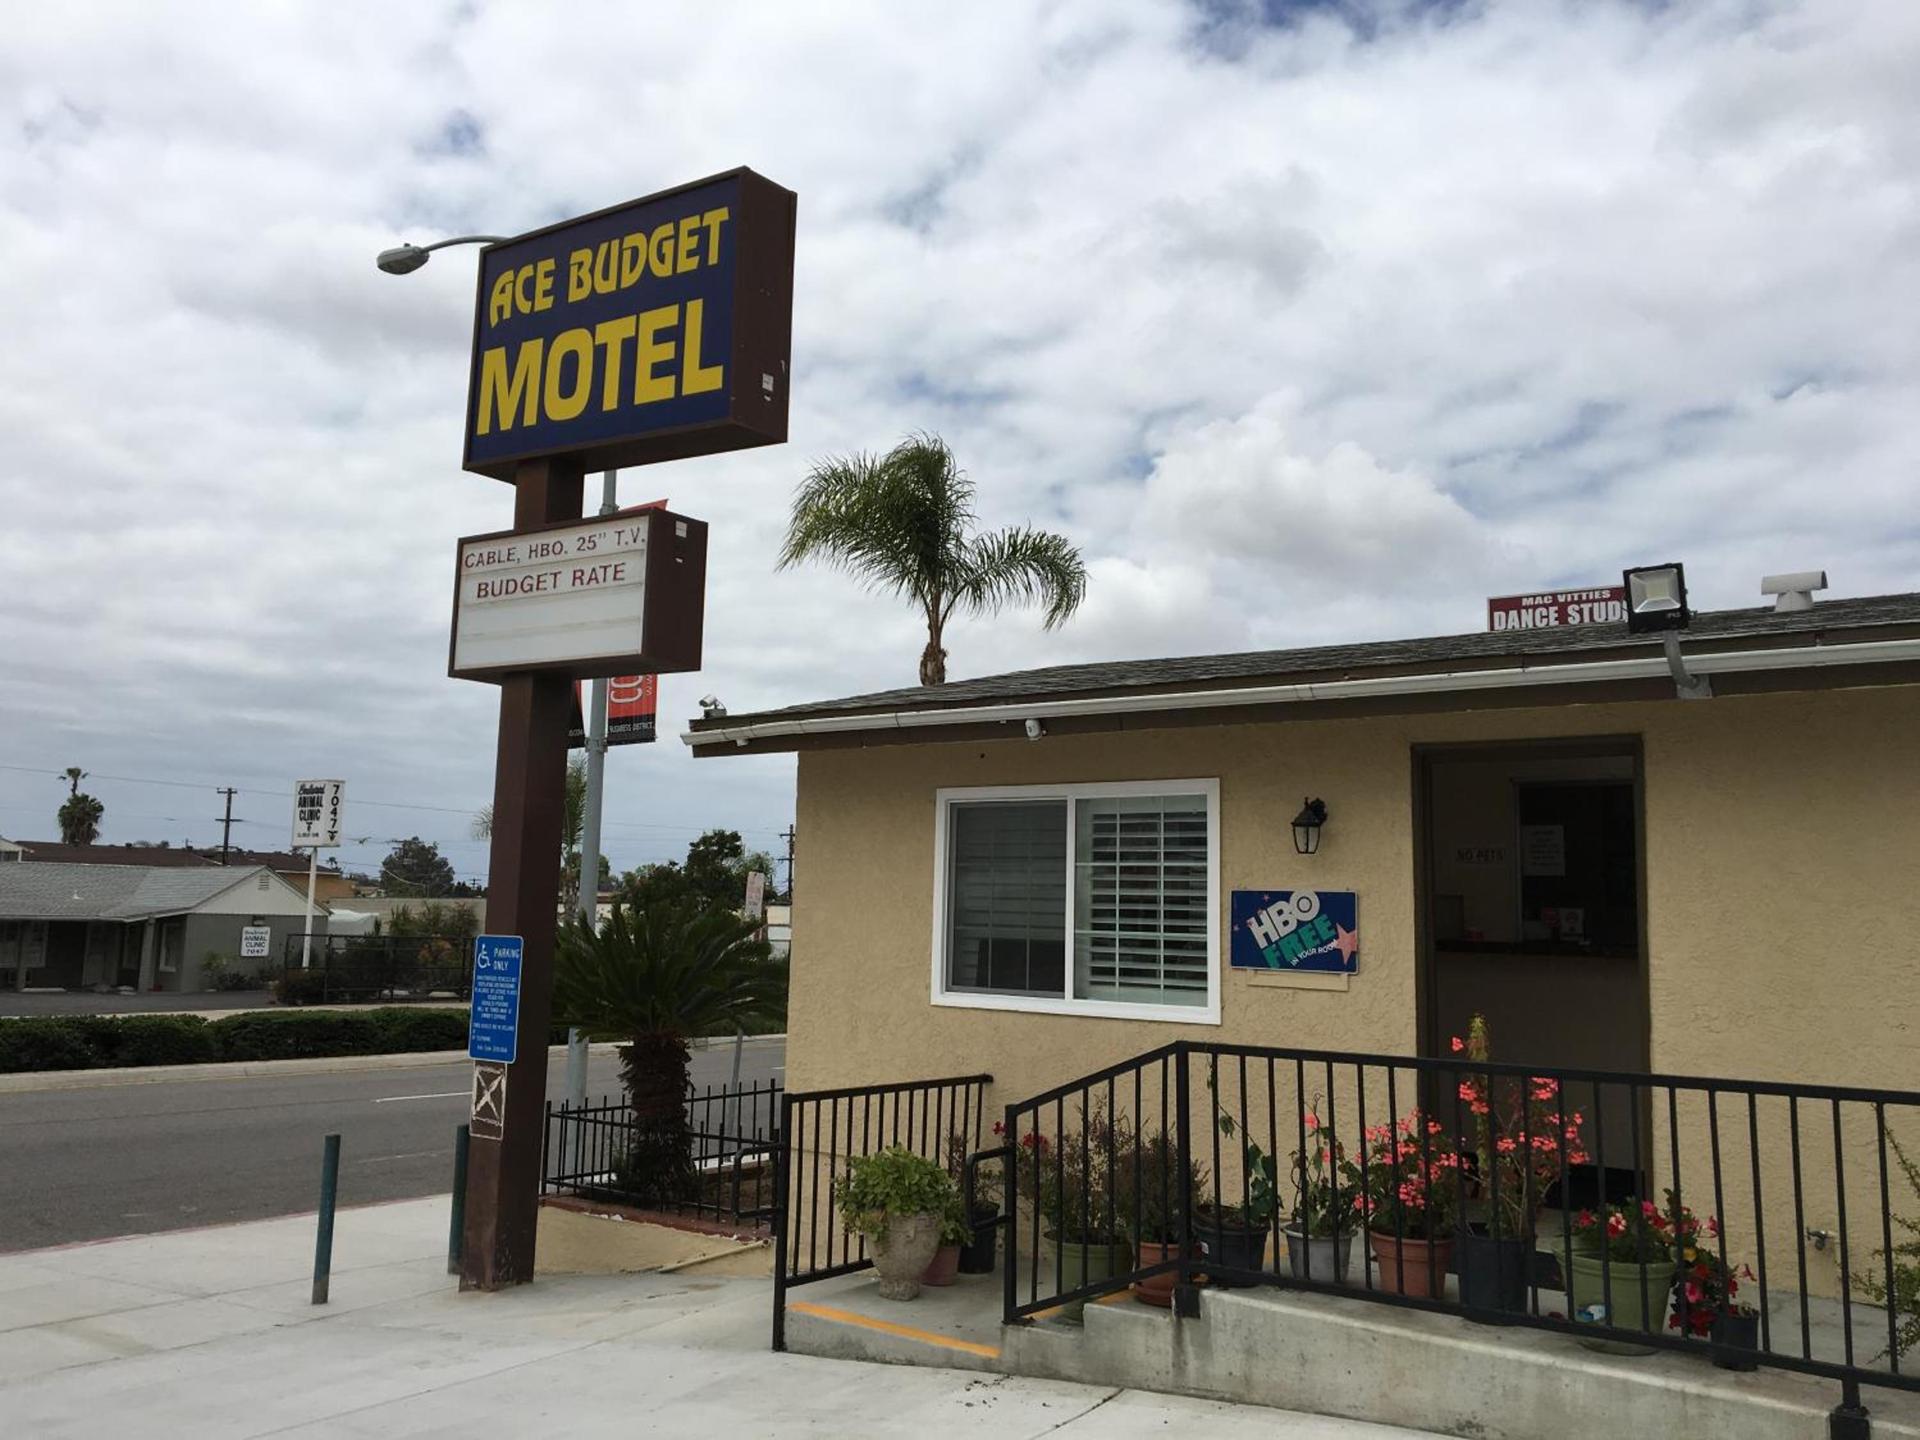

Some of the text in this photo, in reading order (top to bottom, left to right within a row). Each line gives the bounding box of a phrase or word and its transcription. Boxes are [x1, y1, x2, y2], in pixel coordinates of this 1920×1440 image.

[489, 206, 730, 329] ACE BUDGET
[476, 298, 724, 437] MOTEL
[464, 547, 521, 569] CABLE,
[528, 540, 568, 559] HBO.
[614, 526, 646, 547] T.V.
[476, 562, 626, 599] BUDGET RATE
[1521, 589, 1611, 606] MAC VITTIES
[1493, 606, 1560, 631] DANCE
[297, 796, 323, 808] ANIMAL
[299, 809, 321, 821] CLINIC
[330, 784, 340, 829] 7047
[1247, 889, 1320, 949] HBO
[493, 947, 520, 960] PARKING
[1262, 914, 1336, 968] FREE
[1298, 948, 1317, 959] YOUR
[493, 960, 509, 971] ONLY
